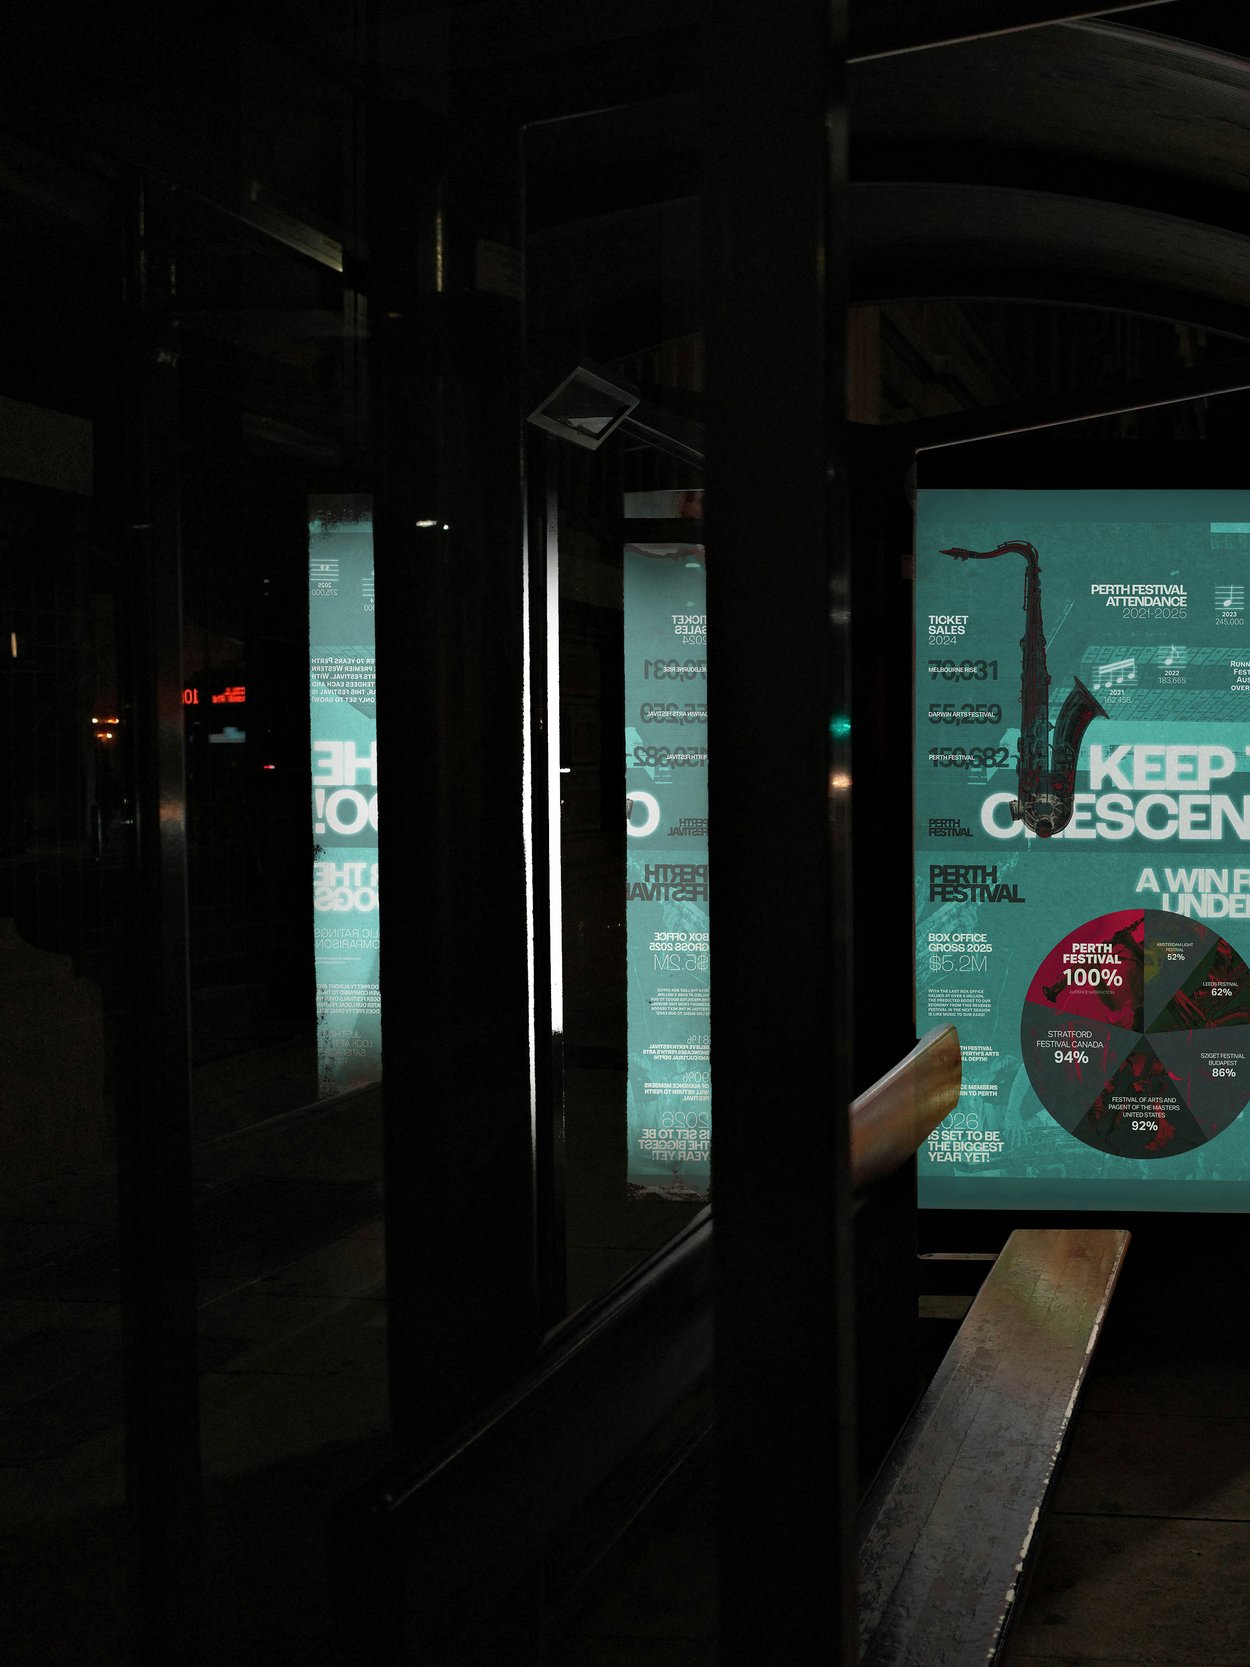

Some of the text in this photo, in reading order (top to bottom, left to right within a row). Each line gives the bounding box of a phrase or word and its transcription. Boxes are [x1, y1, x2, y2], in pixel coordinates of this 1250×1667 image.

[1091, 584, 1187, 594] PERTH FESTIVAL
[1106, 596, 1187, 606] ATTENDANCE
[1122, 608, 1187, 619] 2021-2025
[928, 616, 968, 624] TICKET
[928, 626, 966, 635] SALES
[928, 636, 957, 646] 2024
[1090, 745, 1235, 791] KEEP
[928, 819, 960, 828] PERTH
[928, 828, 973, 836] FESTIVAL
[930, 865, 998, 884] PERTH
[1136, 868, 1160, 893] A
[1165, 868, 1229, 893] WIN
[930, 884, 1026, 903] FESTIVAL
[928, 934, 988, 942] BOX OFFICE
[928, 944, 992, 952] GROSS 2025
[1072, 944, 1112, 953] PERTH
[928, 954, 988, 972] $5.2M
[1063, 954, 1122, 964] FESTIVAL
[1062, 968, 1122, 986] 100%
[1211, 988, 1232, 996] 62%
[1054, 1050, 1089, 1064] 94%
[1212, 1068, 1236, 1078] 86%
[936, 1113, 978, 1130] 026
[1132, 1121, 1158, 1131] 92%
[942, 1131, 964, 1141] SET
[966, 1131, 982, 1141] TO
[985, 1131, 1000, 1141] BE
[928, 1142, 1004, 1152] THE BIGGEST
[928, 1152, 990, 1162] YEAR YET!
